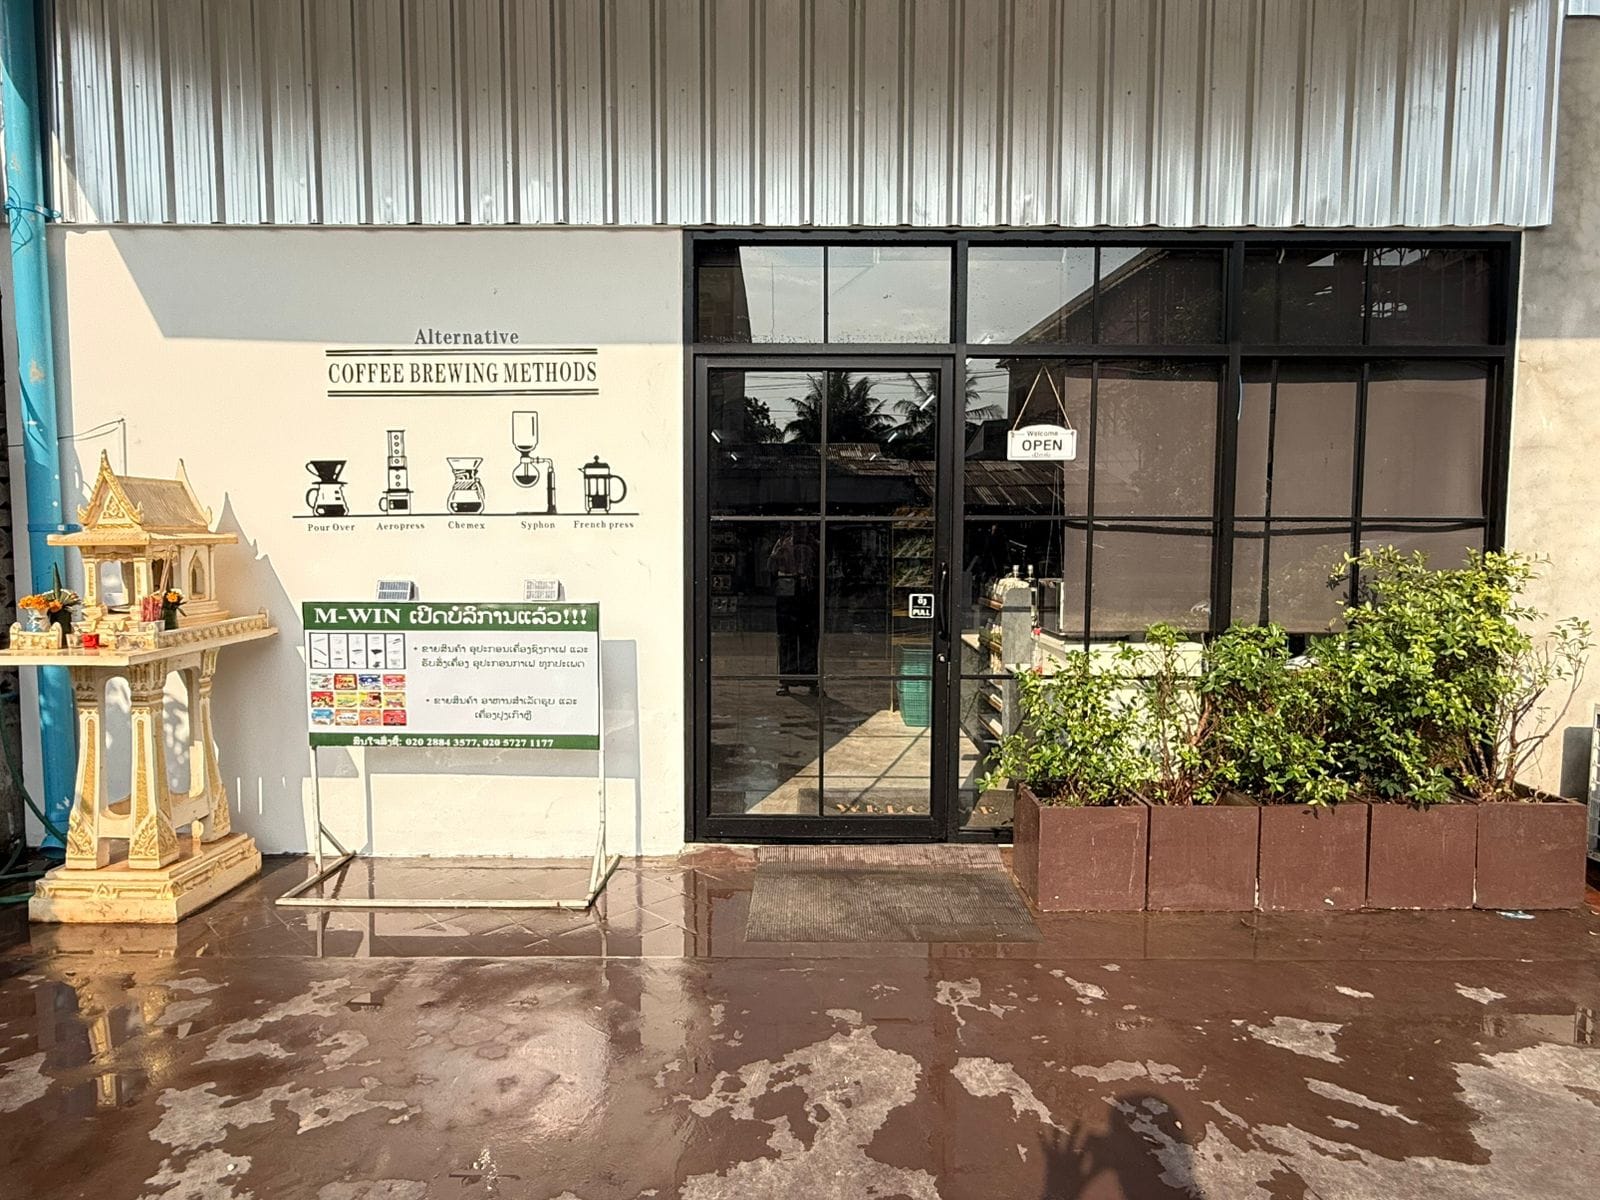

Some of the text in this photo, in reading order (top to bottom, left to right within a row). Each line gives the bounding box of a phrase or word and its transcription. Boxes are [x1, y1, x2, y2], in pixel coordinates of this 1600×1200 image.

[414, 328, 520, 345] Alternative
[328, 361, 597, 384] COFFEE BREWING METHODS
[1022, 439, 1063, 451] OPEN
[307, 523, 355, 532] Pour Over
[376, 521, 426, 531] Aeropress
[447, 521, 486, 530] Chemex
[521, 520, 556, 531] Syphon
[573, 520, 634, 530] French press
[313, 607, 402, 624] M-WIN
[405, 738, 424, 746] 020
[426, 738, 451, 746] 2884
[453, 738, 480, 747] 3577,
[482, 738, 500, 747] 020
[502, 739, 527, 747] 5727
[530, 739, 554, 748] 1177
